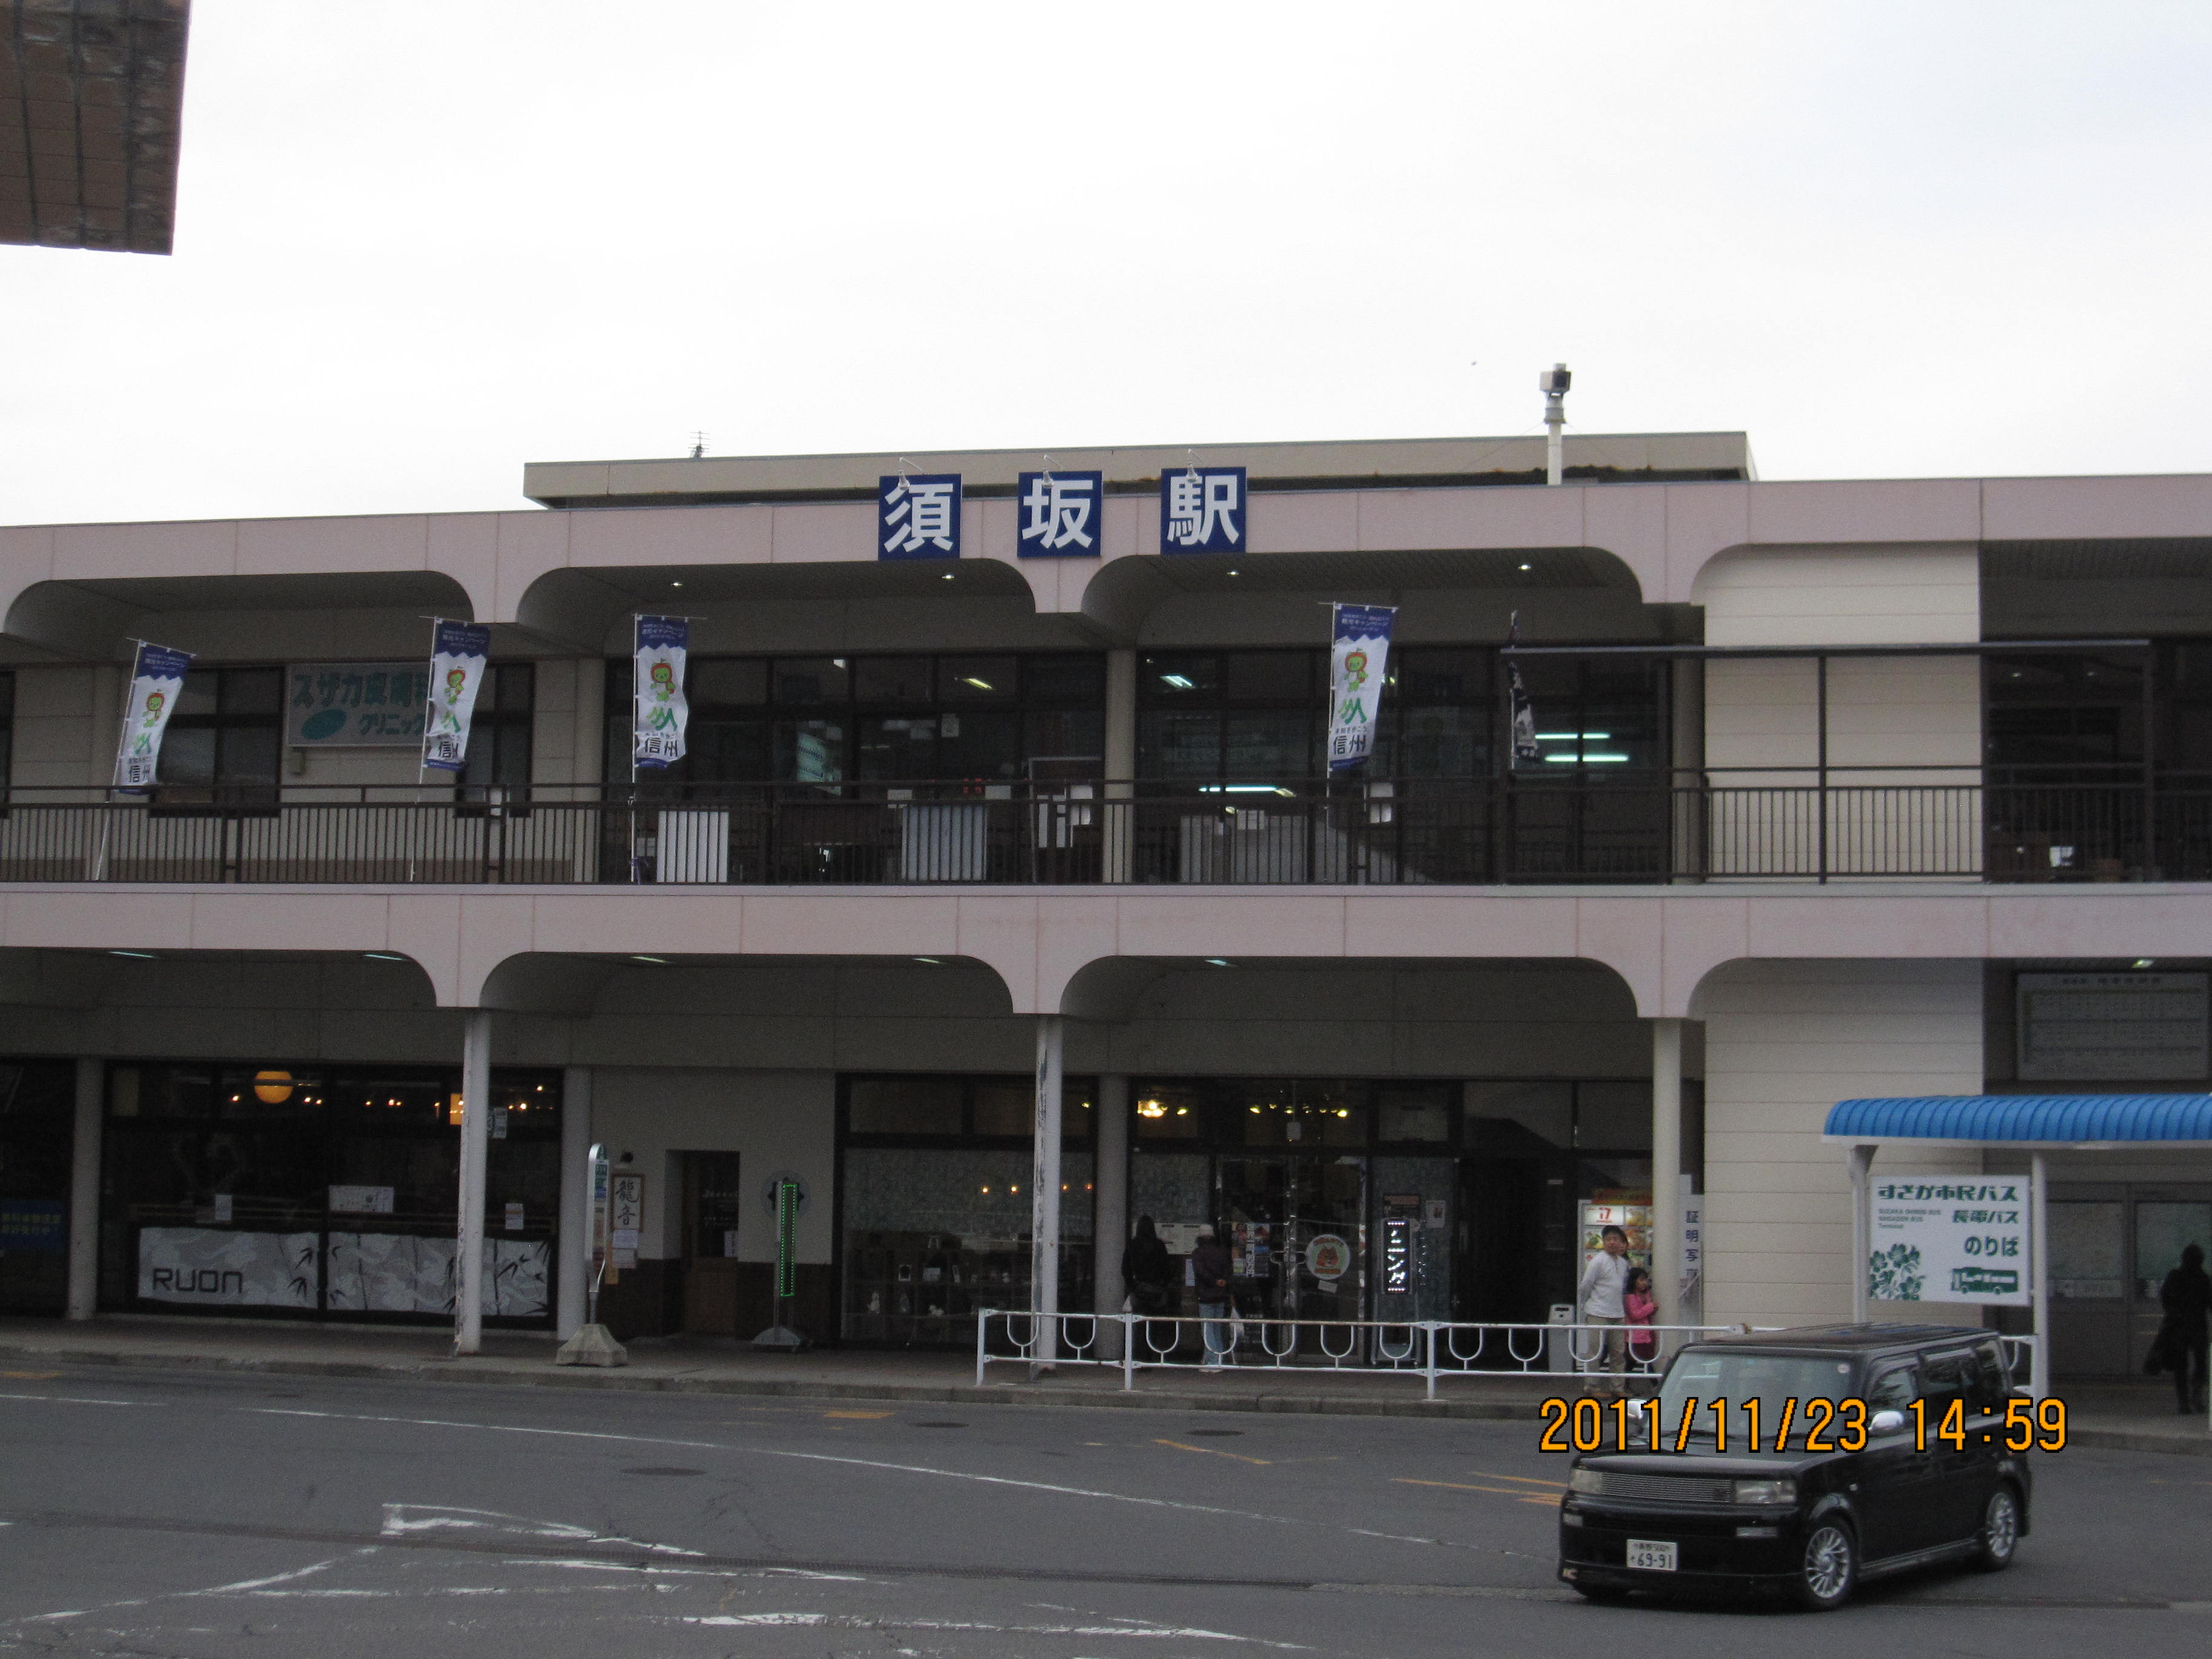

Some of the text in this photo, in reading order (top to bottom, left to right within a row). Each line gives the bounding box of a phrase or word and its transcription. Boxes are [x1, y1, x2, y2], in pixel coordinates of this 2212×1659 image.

[883, 474, 1239, 552] 須坂駅
[644, 737, 678, 757] 信州
[1333, 735, 1366, 755] 信州
[1877, 1184, 2019, 1201] すざか市民バス
[1965, 1236, 2019, 1257] のりば
